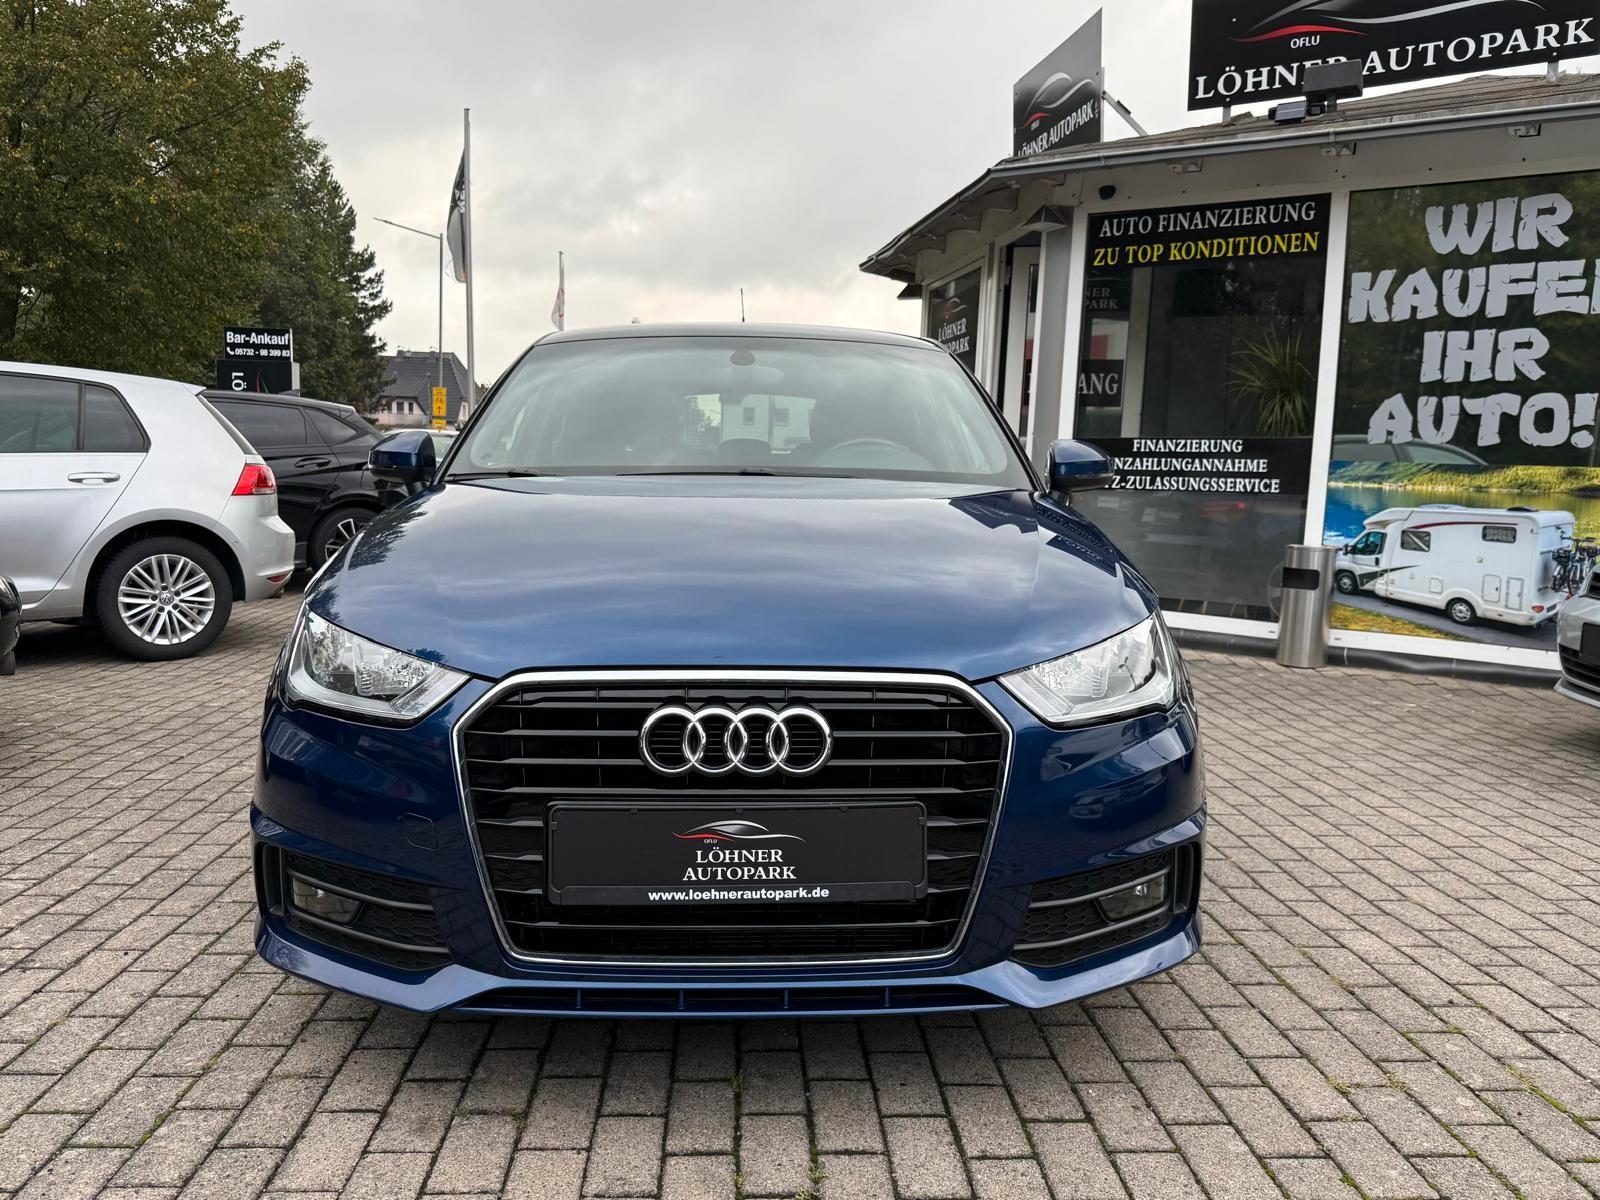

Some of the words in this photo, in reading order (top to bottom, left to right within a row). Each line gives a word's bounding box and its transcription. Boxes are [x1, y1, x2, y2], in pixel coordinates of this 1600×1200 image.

[1290, 35, 1320, 49] OFLU
[1195, 56, 1347, 99] LÖHN
[1362, 17, 1595, 75] AUTOPARK
[1048, 98, 1094, 147] AUTOPARK
[1099, 215, 1152, 237] AUTO
[1157, 201, 1316, 233] FINANZIERUNG
[1425, 192, 1573, 255] WIR
[1093, 248, 1119, 266] ZU
[1125, 244, 1164, 264] TOP
[1168, 231, 1320, 261] KONDITIONEN
[1348, 258, 1600, 323] KAUFE
[226, 331, 289, 345] Bar-Ankauf
[938, 317, 967, 342] LÖHNER
[234, 348, 254, 356] 05732
[1420, 327, 1550, 383] IHR
[1367, 392, 1599, 449] AUTO!
[1132, 439, 1243, 453] FINANZIERUNG
[1104, 475, 1280, 493] Z-ZULASSUNGSSERVICE
[695, 846, 783, 863] LÖHNER
[682, 866, 797, 881] AUTOPARK
[648, 887, 830, 901] www.loehnerautopark.de
